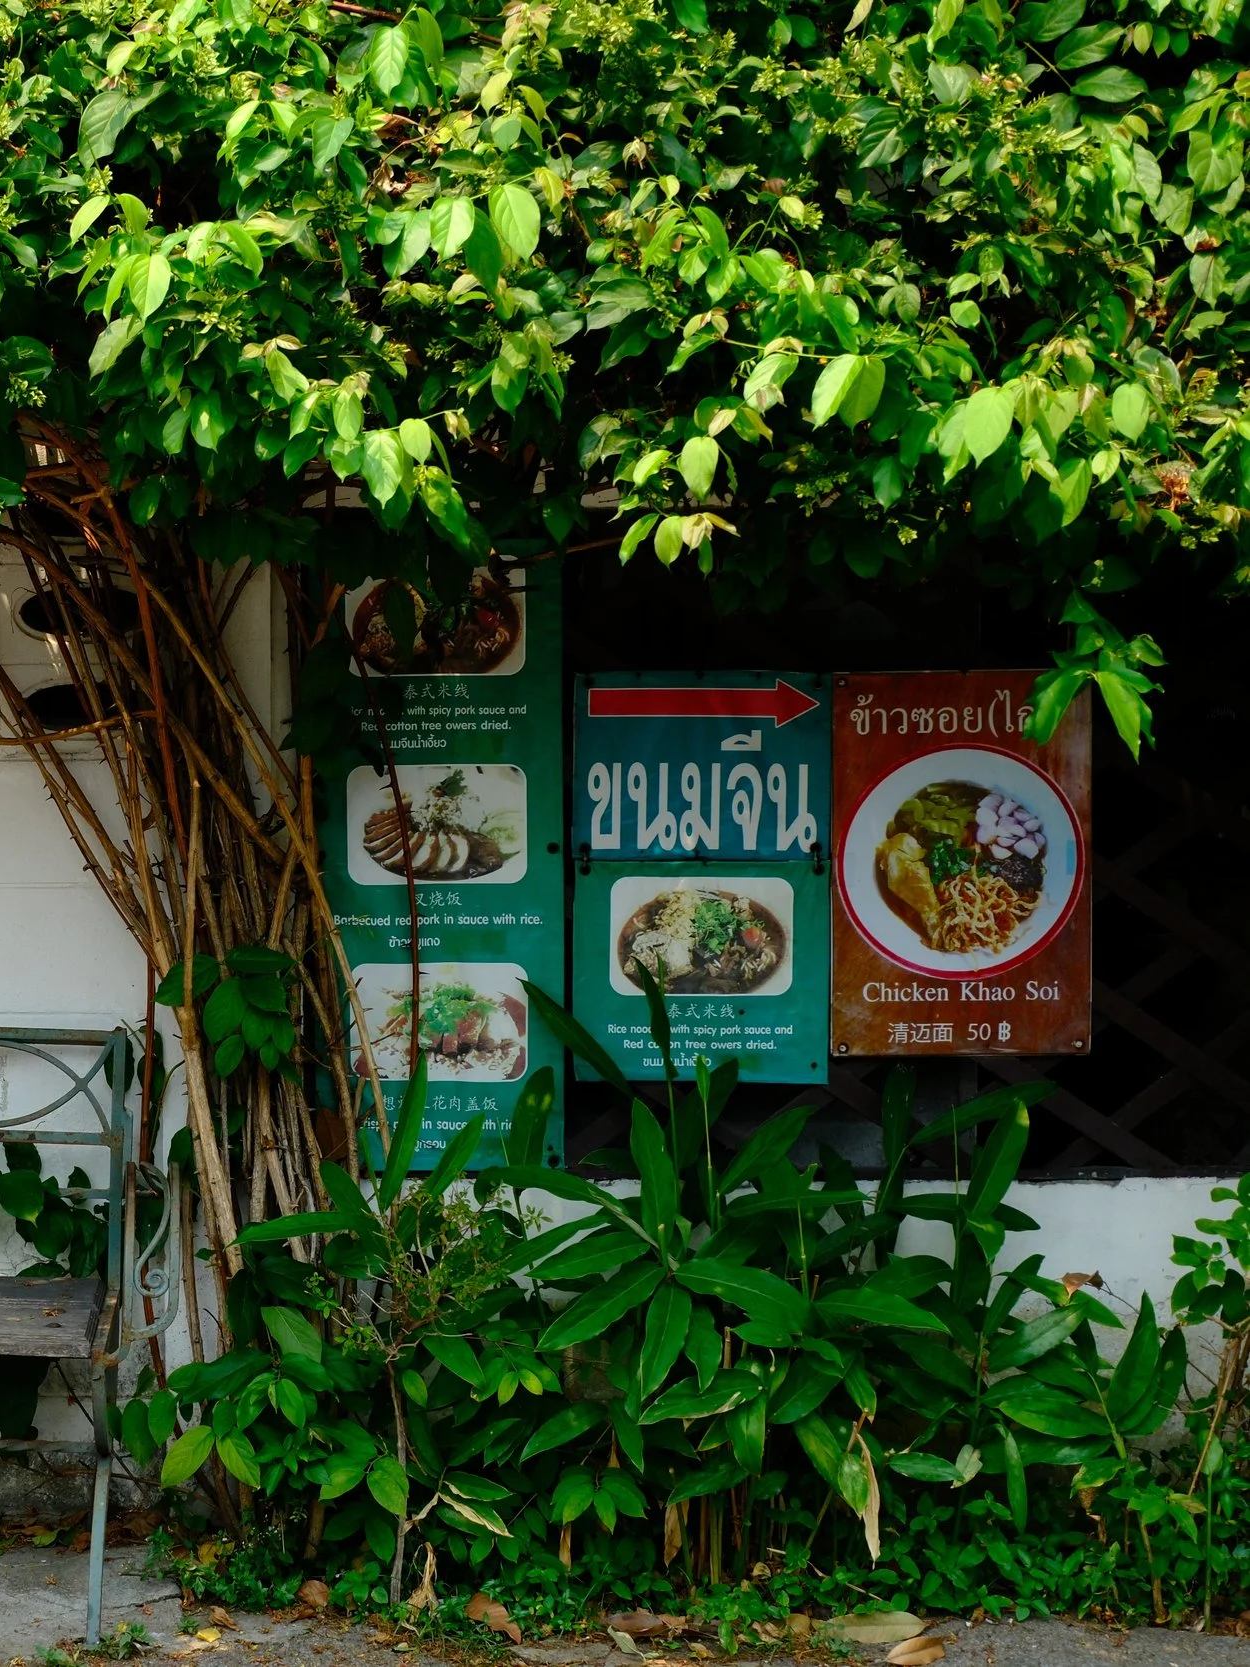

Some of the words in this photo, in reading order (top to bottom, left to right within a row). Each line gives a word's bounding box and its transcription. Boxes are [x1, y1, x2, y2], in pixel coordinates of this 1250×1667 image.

[402, 682, 470, 700] 泰式米线
[406, 705, 426, 716] with
[428, 705, 452, 718] spicy
[454, 705, 476, 718] pork
[478, 706, 506, 715] sauce
[508, 704, 527, 715] and
[849, 689, 1034, 738] ข้าวซอย(ไก
[385, 721, 418, 731] cotton
[421, 721, 442, 731] tree
[445, 722, 477, 731] owers
[480, 720, 512, 731] dried.
[587, 730, 818, 853] ขนมจีน
[333, 914, 391, 926] Barbecued
[395, 914, 412, 926] red
[417, 914, 440, 928] pork
[444, 914, 454, 925] in
[458, 915, 489, 925] sauce
[493, 913, 517, 925] with
[520, 913, 543, 925] rice.
[861, 981, 950, 1003] Chicken
[959, 981, 1016, 1002] Khao
[1025, 980, 1060, 1001] Soi
[667, 1002, 736, 1019] 泰式米线
[607, 1023, 627, 1034] Rice
[670, 1023, 690, 1034] with
[693, 1024, 717, 1037] spicy
[720, 1023, 742, 1037] pork
[744, 1025, 772, 1034] sauce
[774, 1024, 793, 1035] and
[887, 1022, 954, 1044] 清迈面
[967, 1022, 992, 1041] 50
[623, 1039, 644, 1049] Red
[685, 1040, 707, 1049] tree
[710, 1041, 742, 1050] owers
[746, 1039, 778, 1050] dried.
[421, 1117, 432, 1130] in
